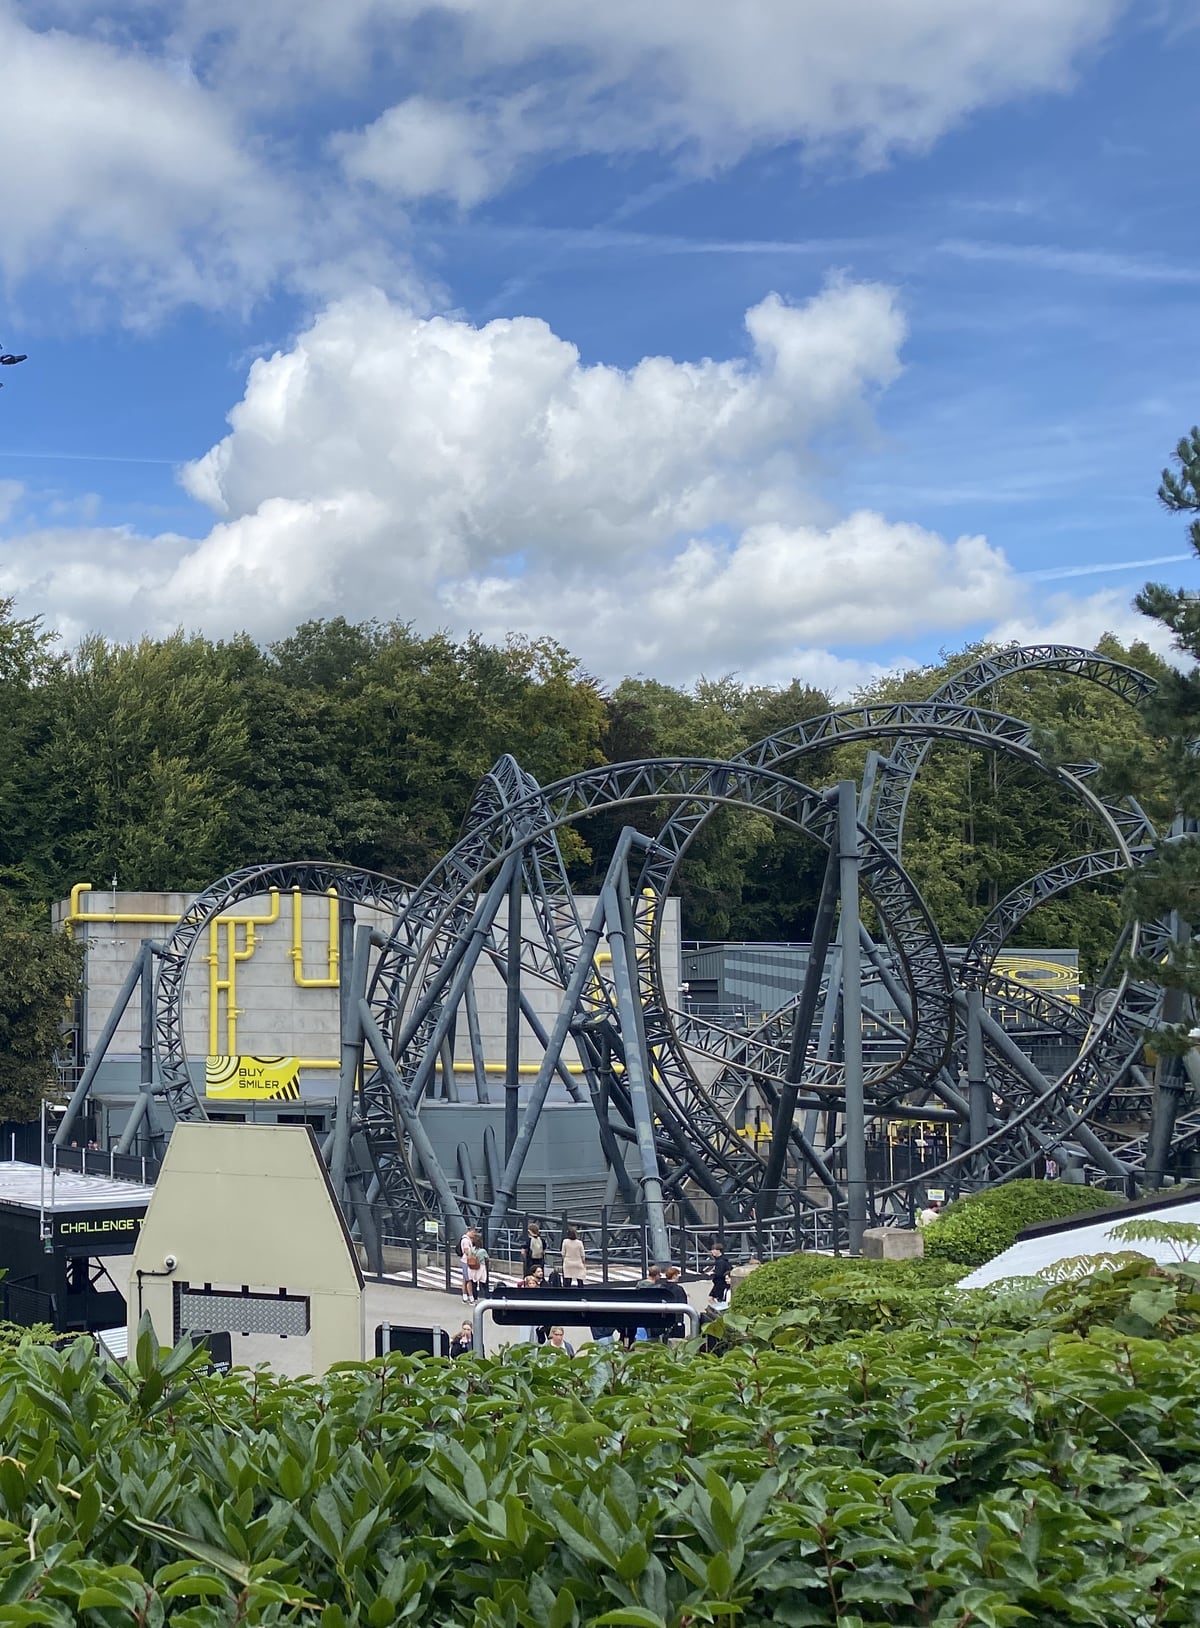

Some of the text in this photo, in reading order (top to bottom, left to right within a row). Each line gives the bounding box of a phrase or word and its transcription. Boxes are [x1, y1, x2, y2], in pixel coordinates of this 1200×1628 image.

[239, 1068, 265, 1077] BUY
[239, 1080, 279, 1089] SMILER
[60, 1219, 135, 1234] CHALLENGE
